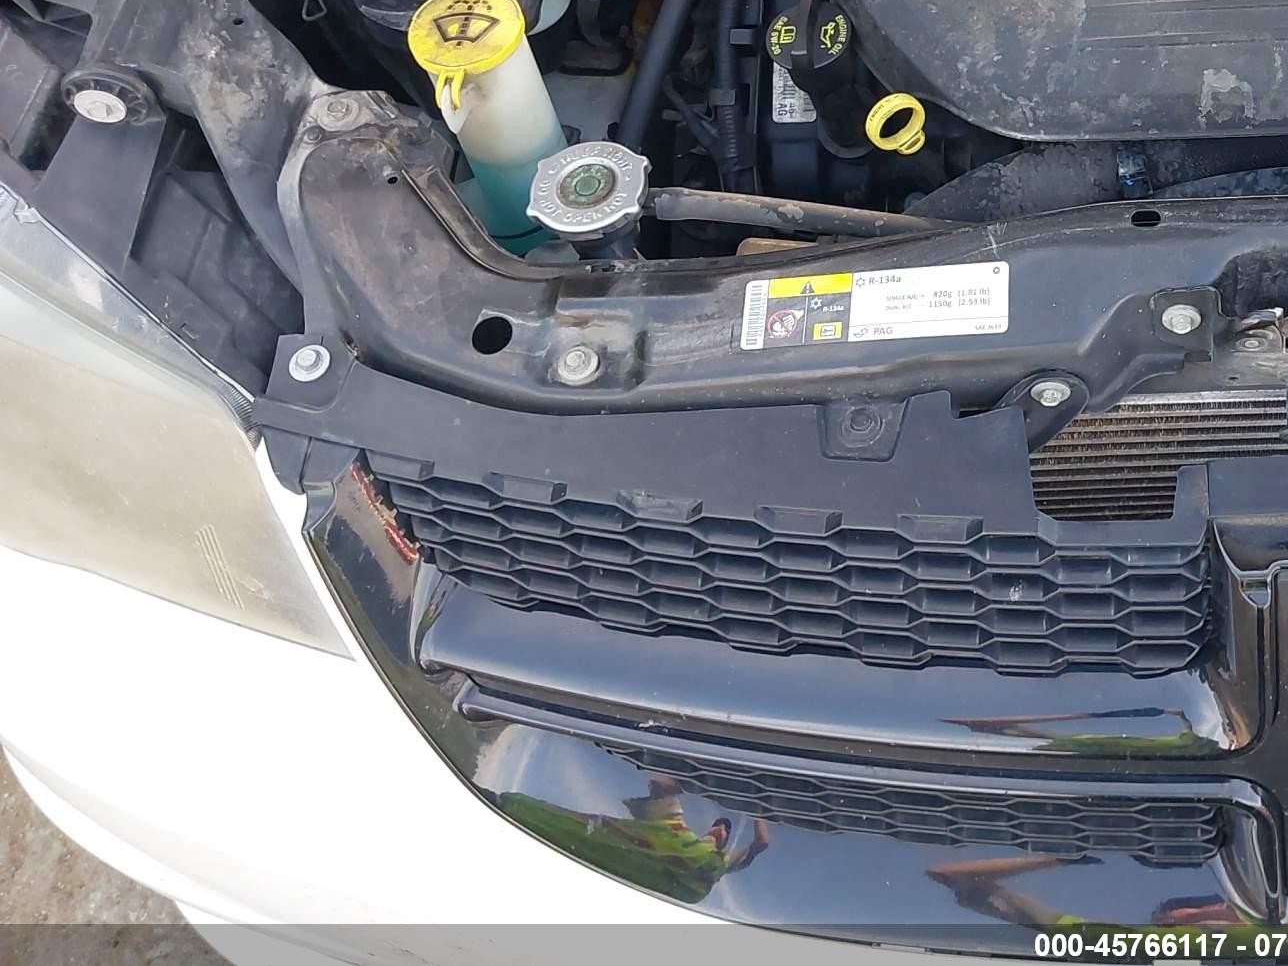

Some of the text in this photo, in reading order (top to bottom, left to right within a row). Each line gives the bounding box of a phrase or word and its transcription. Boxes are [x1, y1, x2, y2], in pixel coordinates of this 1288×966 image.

[828, 14, 848, 55] ENGINE OIL
[868, 275, 901, 285] R-134a
[873, 326, 893, 335] PAG
